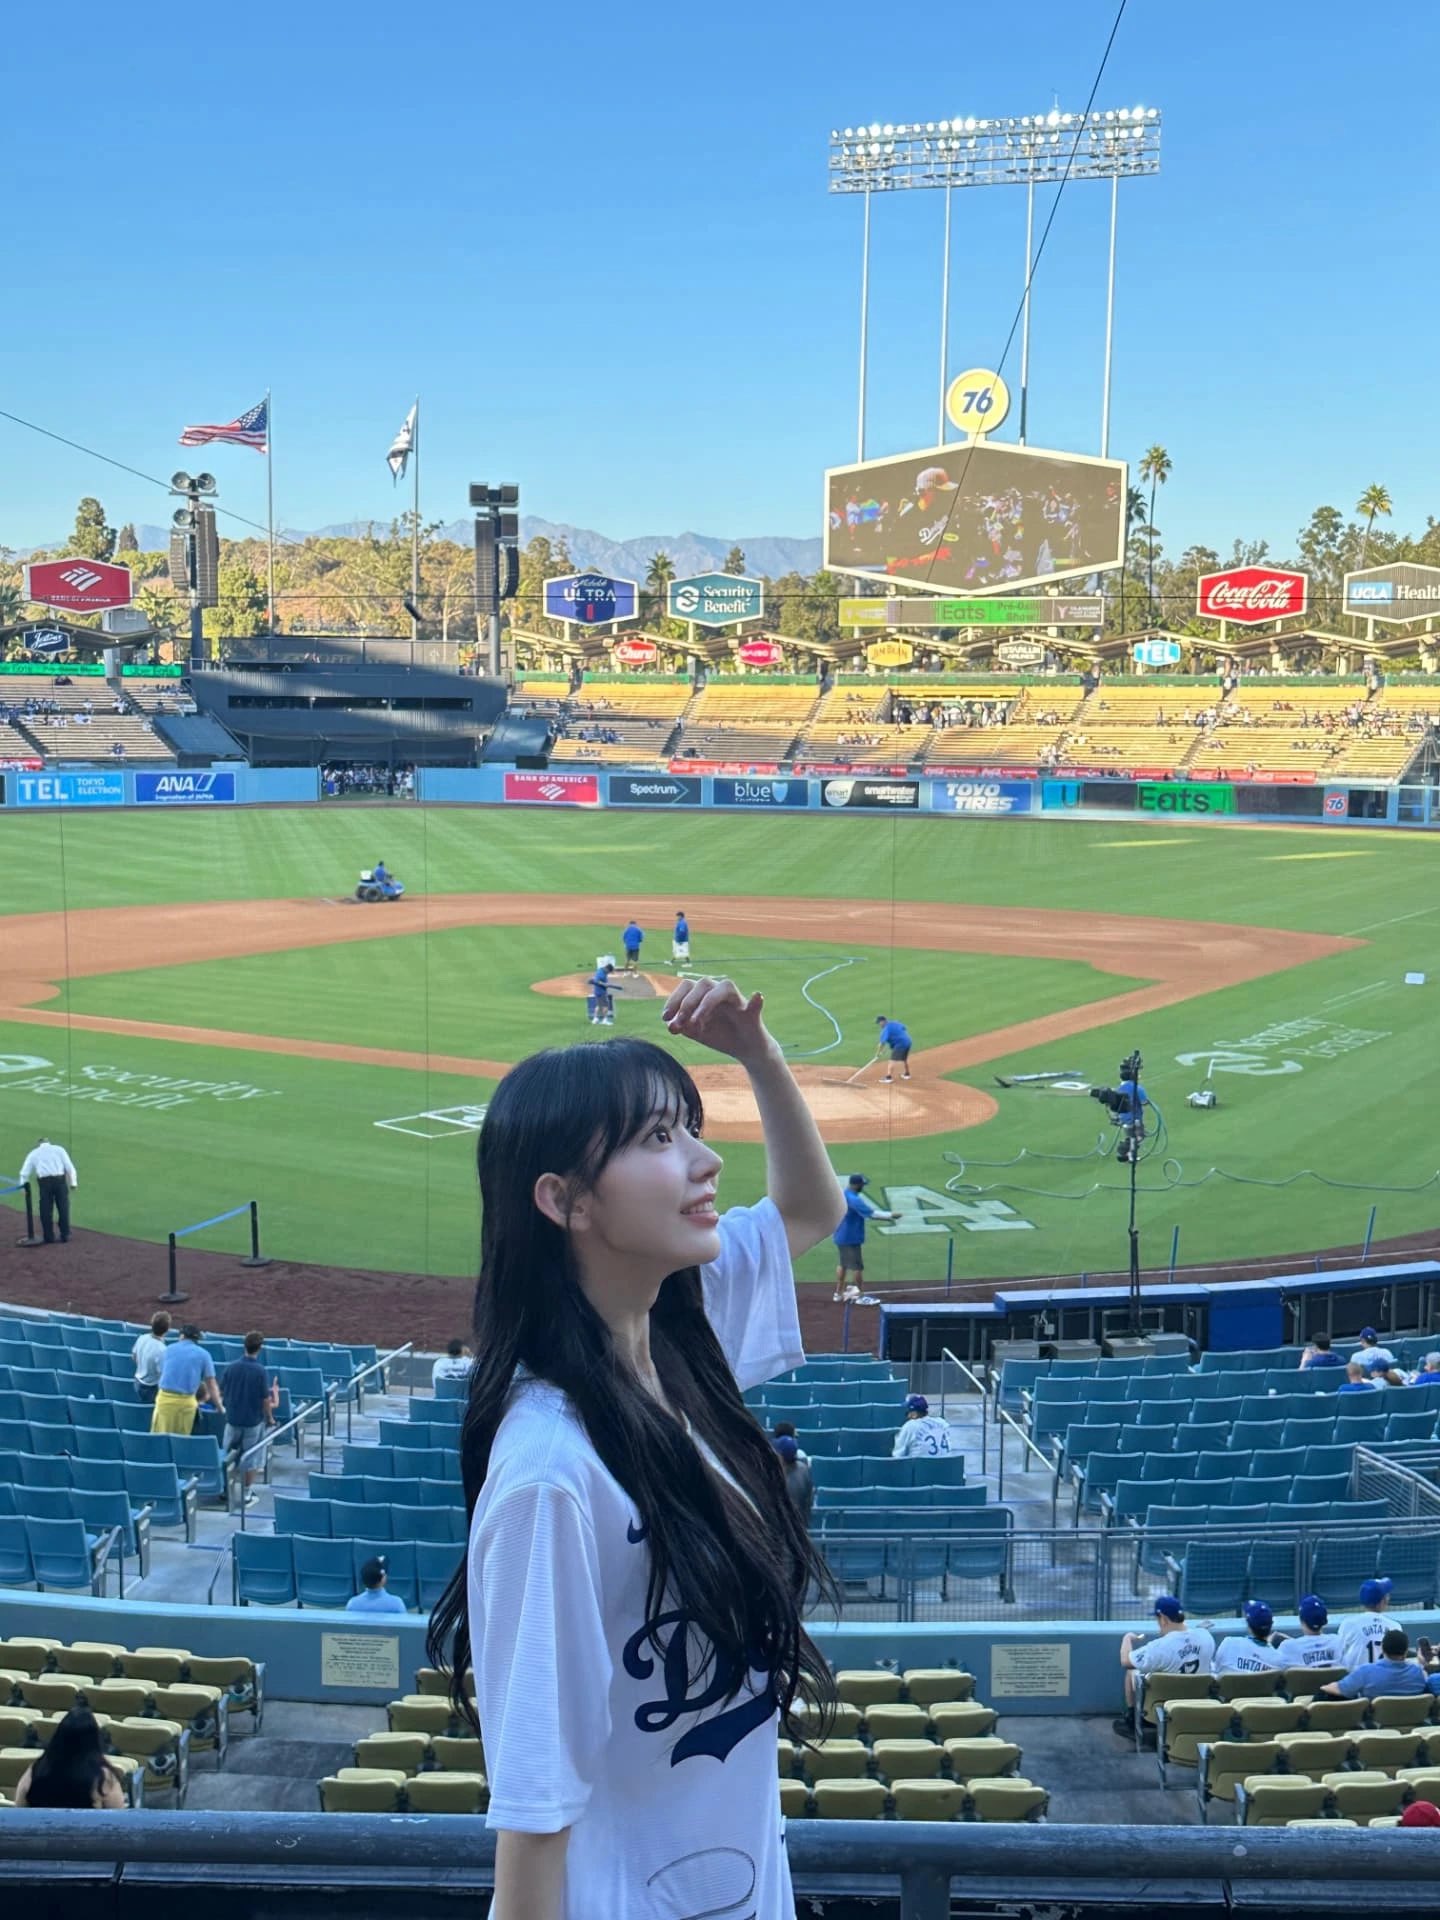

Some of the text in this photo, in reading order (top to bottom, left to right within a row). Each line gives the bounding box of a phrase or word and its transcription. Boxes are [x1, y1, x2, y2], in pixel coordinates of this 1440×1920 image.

[961, 387, 993, 414] 76
[563, 588, 617, 602] ULTRA
[703, 585, 754, 602] Security
[1207, 579, 1295, 610] Coca-Cola
[1350, 585, 1440, 600] UCLA Healt
[703, 600, 747, 613] Benefit
[942, 604, 985, 621] Eats
[76, 778, 105, 787] TOKYO
[155, 776, 195, 792] ANA
[514, 775, 588, 784] BANK OF AMERICA
[19, 778, 69, 801] TEL
[78, 786, 121, 796] ELECTRON
[630, 783, 677, 796] Spectrum
[734, 782, 771, 798] blue
[946, 783, 1001, 797] TOYO
[954, 796, 1013, 811] TIRES
[1139, 786, 1210, 812] Eats
[1327, 798, 1344, 810] 76
[924, 1433, 950, 1456] 34
